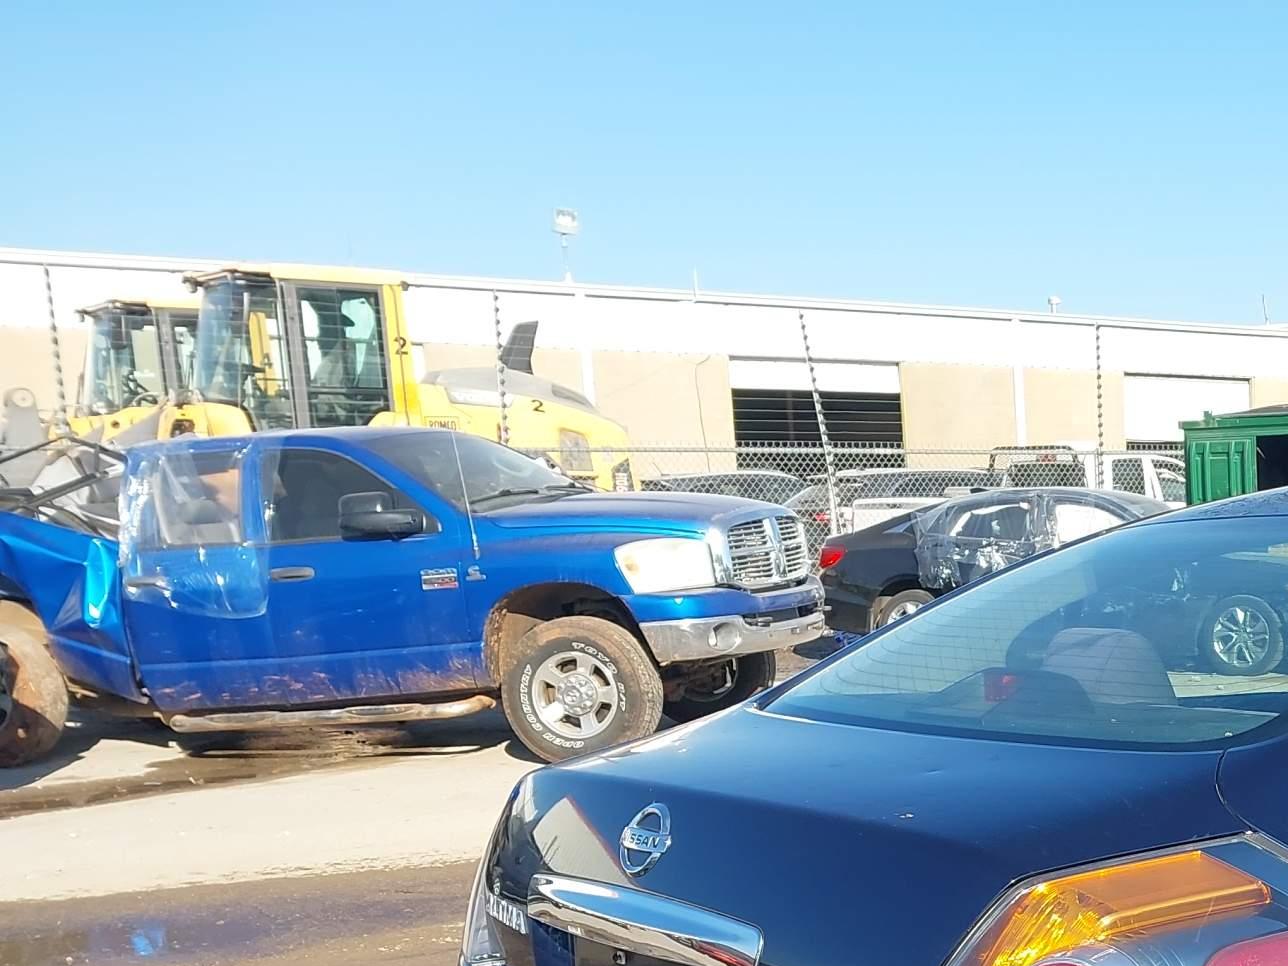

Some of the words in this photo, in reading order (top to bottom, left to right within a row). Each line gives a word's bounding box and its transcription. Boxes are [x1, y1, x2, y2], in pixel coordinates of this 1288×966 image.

[394, 336, 409, 355] 2
[531, 399, 545, 413] 2
[571, 641, 618, 675] TOYO
[519, 663, 544, 732] COUNTRY
[541, 731, 586, 749] OPEN
